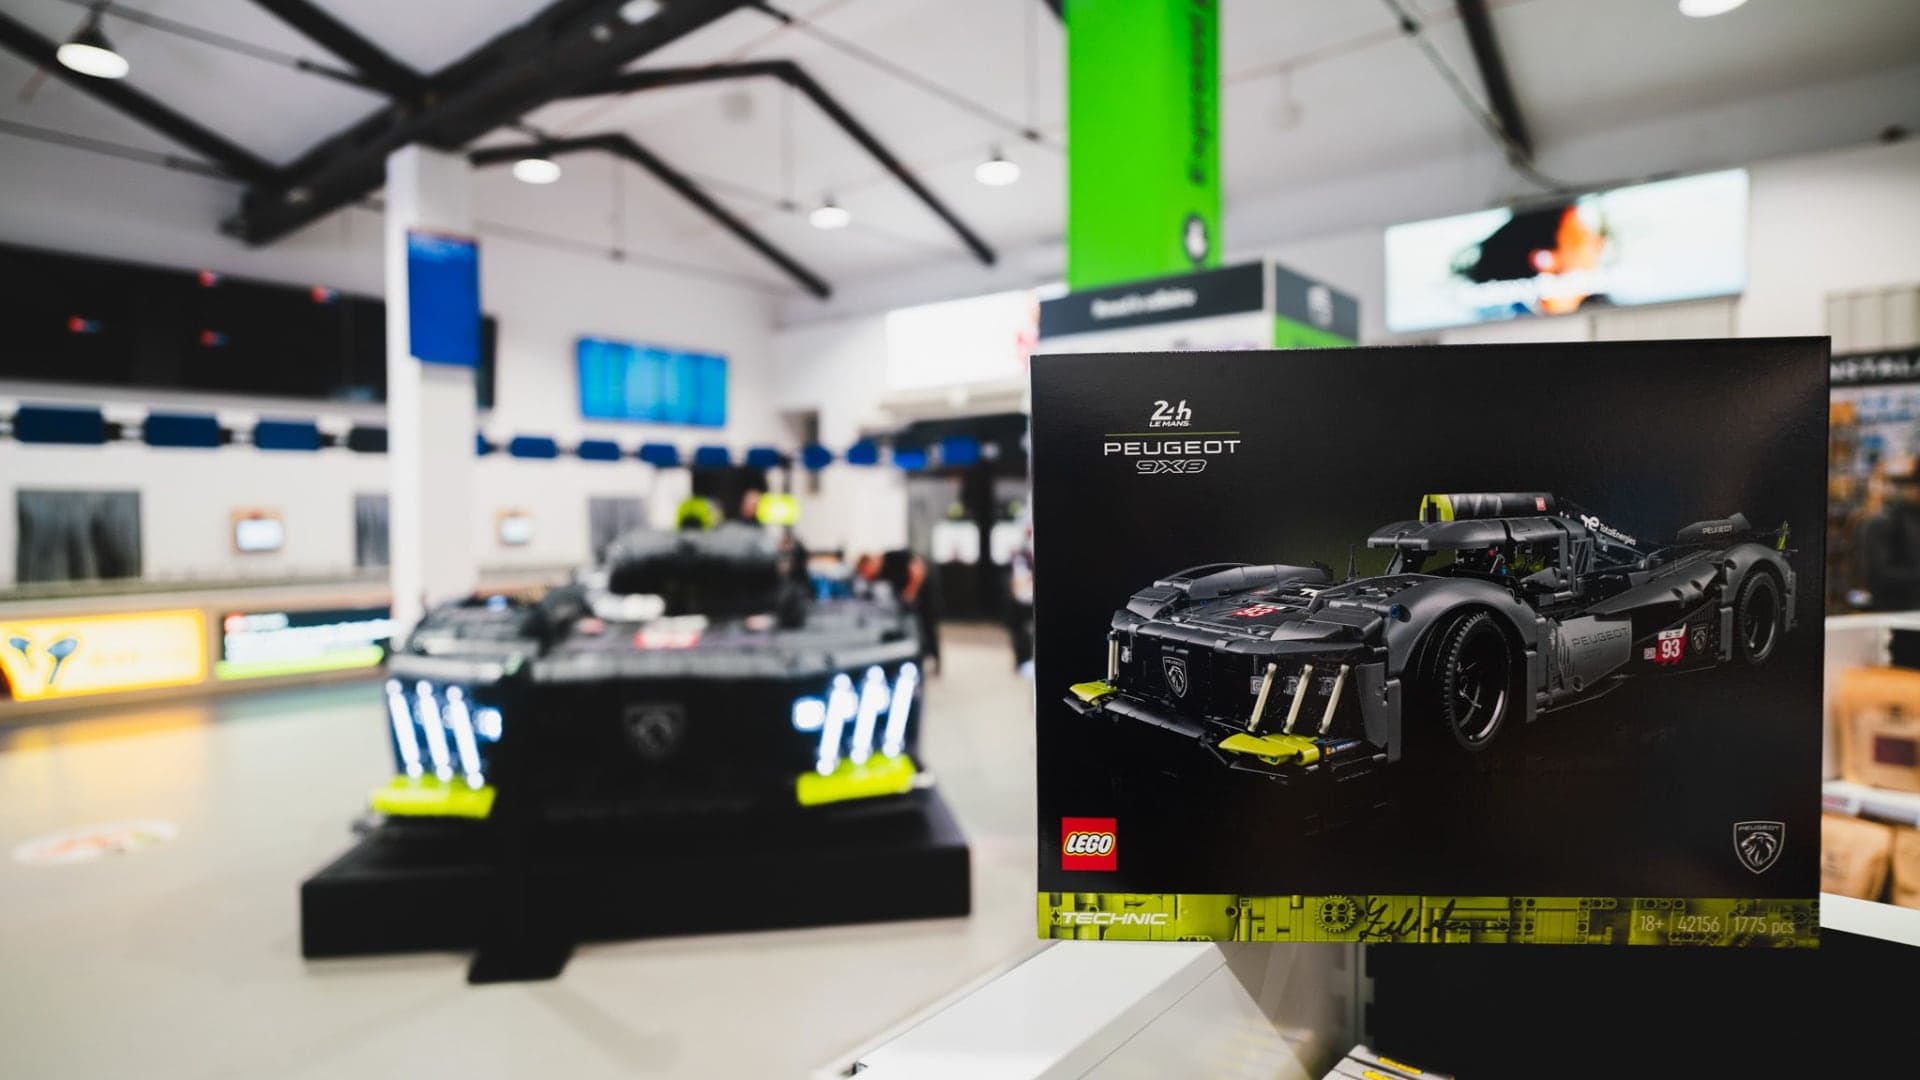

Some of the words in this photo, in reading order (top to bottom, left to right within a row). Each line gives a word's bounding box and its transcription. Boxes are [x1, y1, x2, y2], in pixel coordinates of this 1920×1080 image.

[1151, 400, 1192, 420] 24h
[1104, 440, 1241, 456] PEUGEOT
[1136, 459, 1207, 474] 9X8
[1571, 627, 1629, 647] PEUGEOT
[1661, 640, 1680, 659] 93
[1065, 833, 1114, 855] LEGO
[1062, 911, 1169, 926] TECHNIC
[1639, 915, 1665, 932] 18+
[1678, 915, 1720, 933] 42156
[1733, 916, 1767, 934] 1775
[1771, 920, 1795, 936] pcs
